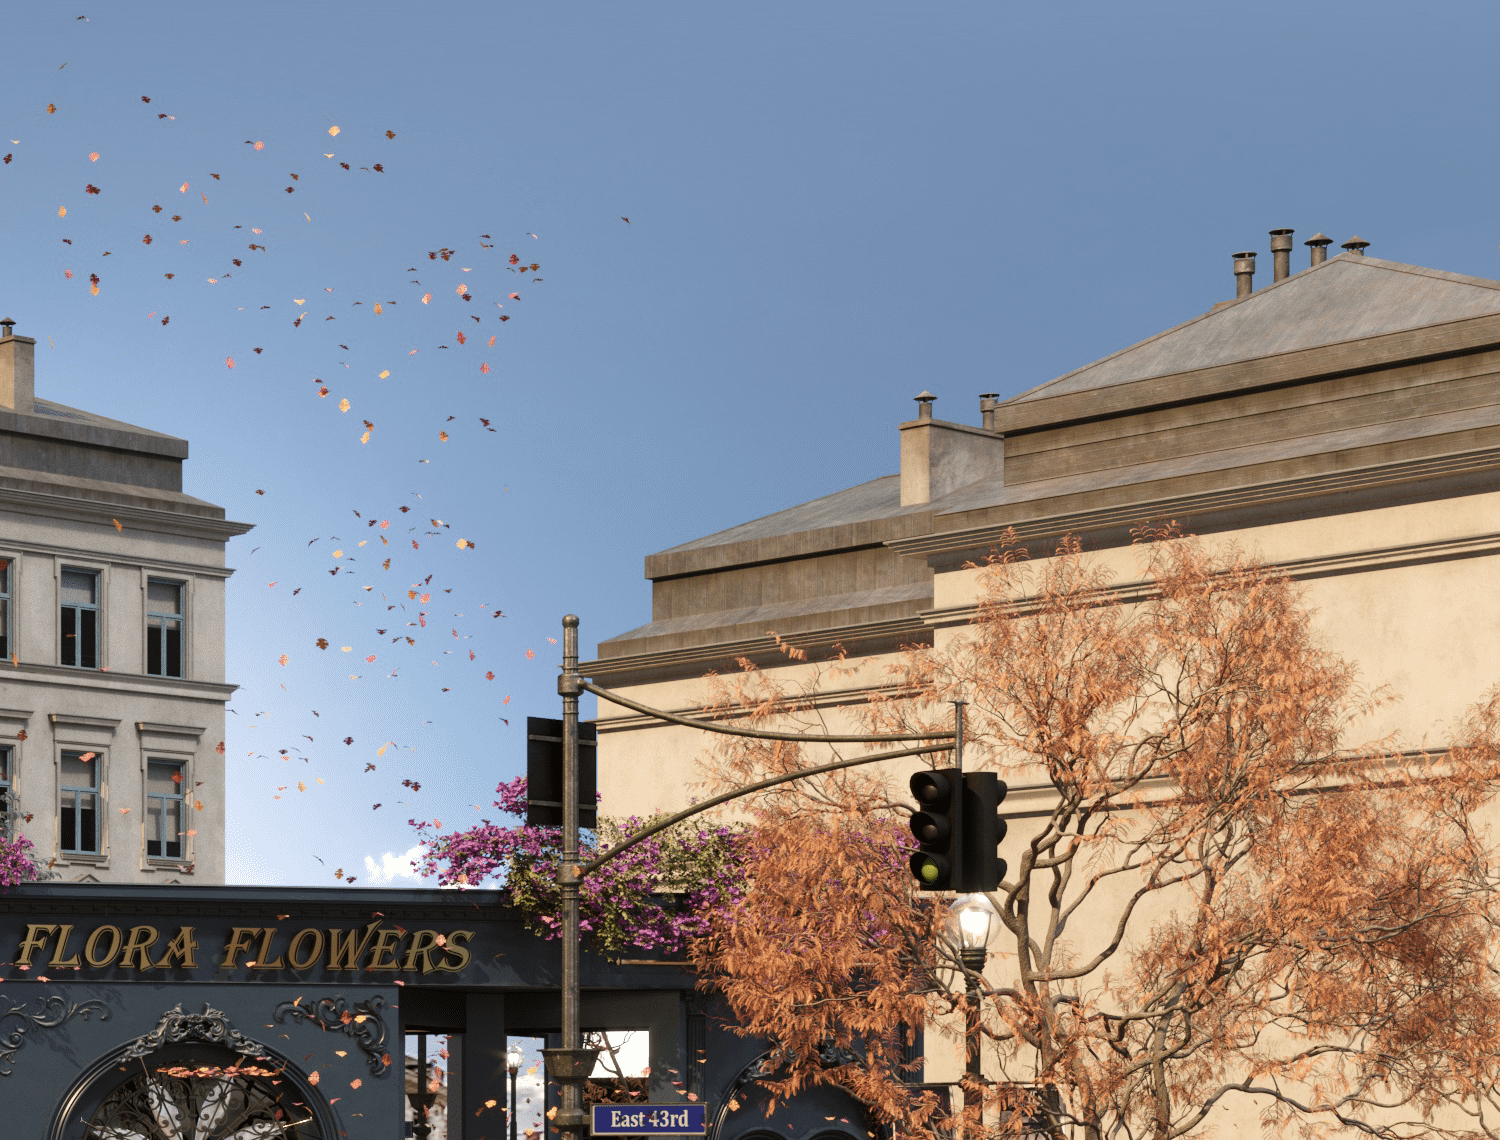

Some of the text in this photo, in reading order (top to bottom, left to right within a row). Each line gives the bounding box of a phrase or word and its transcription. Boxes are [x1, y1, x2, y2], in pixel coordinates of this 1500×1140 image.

[15, 919, 476, 975] FLORA FLOWERS
[610, 1109, 689, 1128] East 43rd
